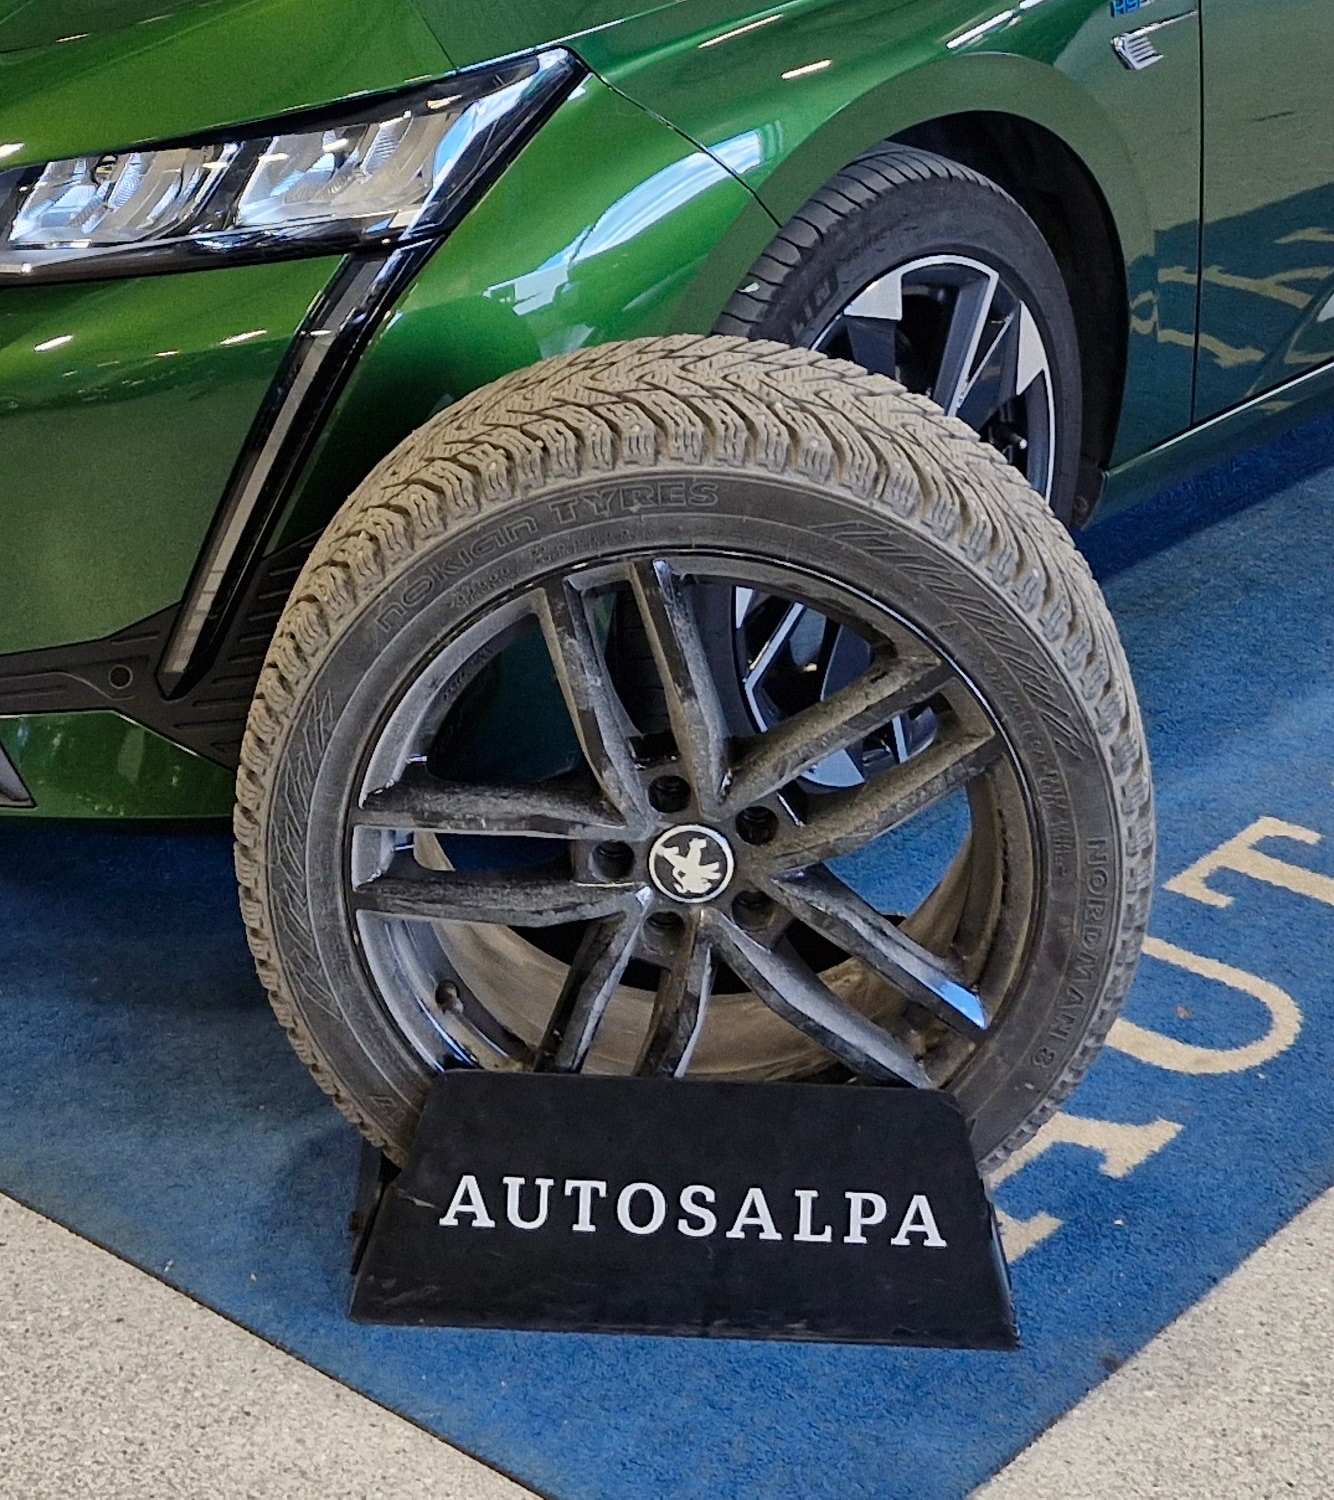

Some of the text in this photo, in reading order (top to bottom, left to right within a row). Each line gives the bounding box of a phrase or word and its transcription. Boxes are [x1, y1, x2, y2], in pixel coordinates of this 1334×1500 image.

[549, 480, 720, 525] TYRES
[1048, 836, 1108, 1042] NORDMAN
[439, 1174, 948, 1248] AUTOSALPA
